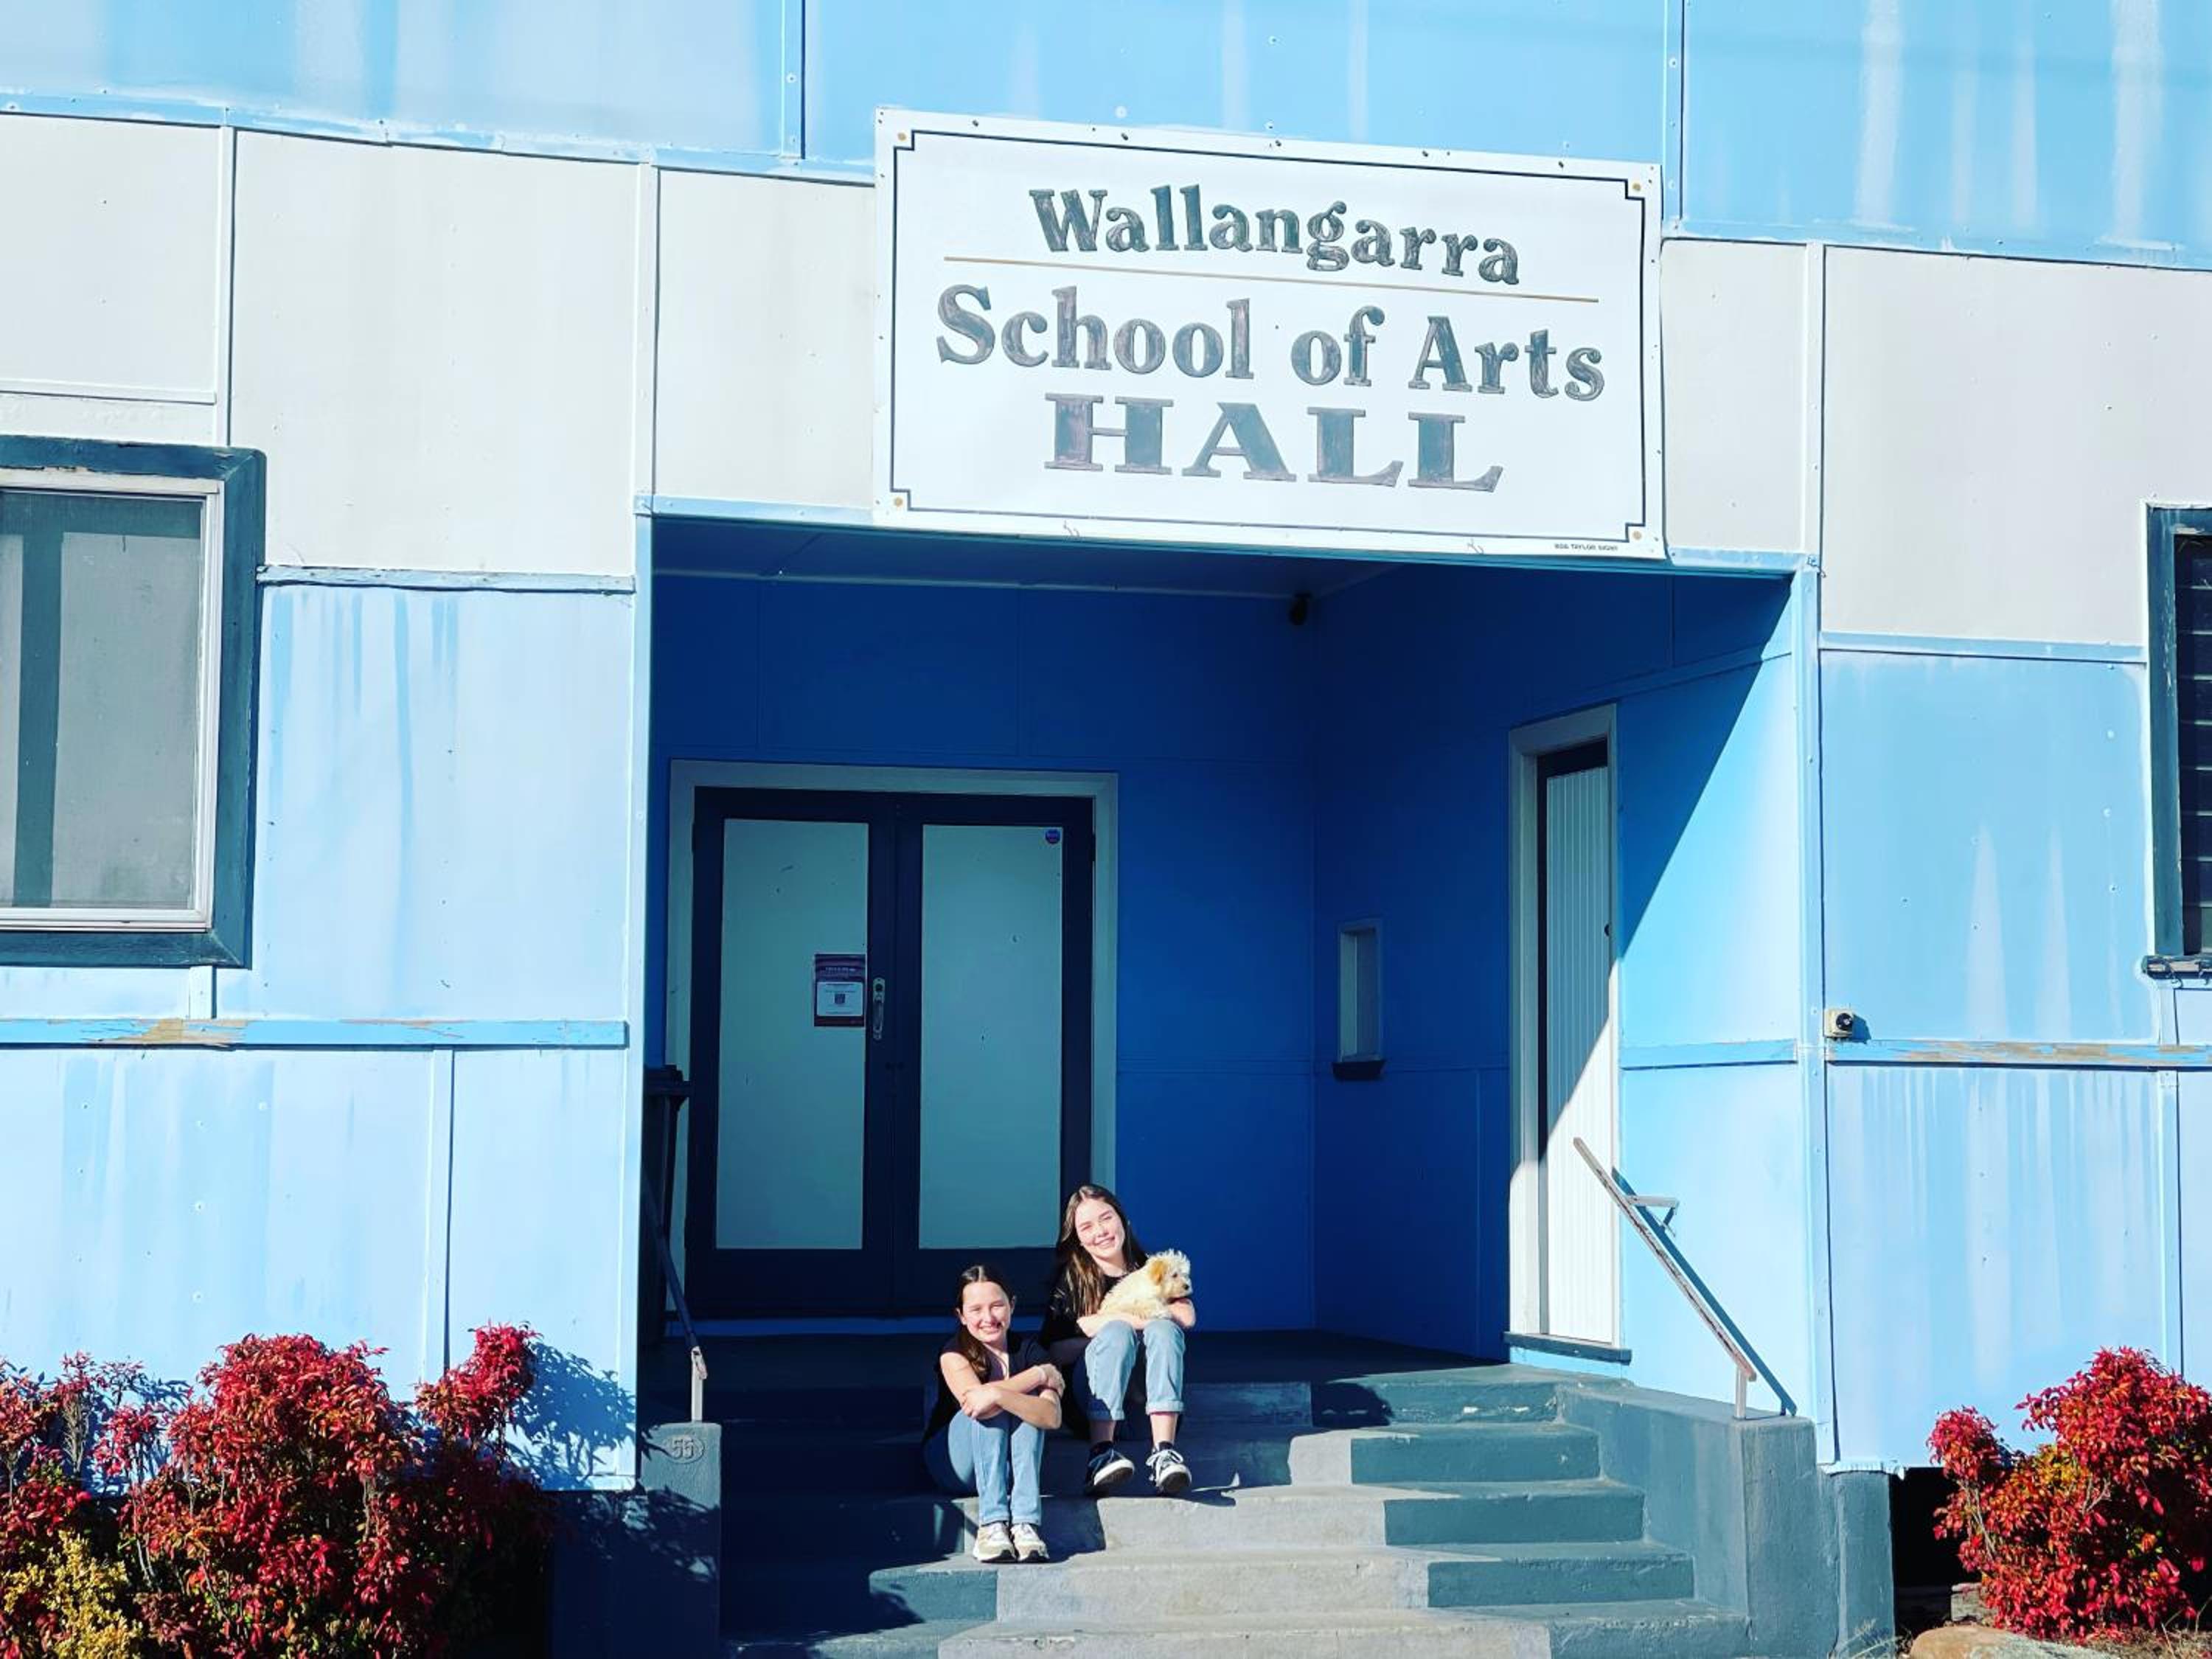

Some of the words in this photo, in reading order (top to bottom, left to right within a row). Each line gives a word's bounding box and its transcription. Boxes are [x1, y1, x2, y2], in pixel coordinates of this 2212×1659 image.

[1029, 184, 1520, 285] Wallangarra
[936, 285, 1254, 379] School
[1291, 305, 1385, 387] of
[1408, 316, 1606, 401] Arts
[1044, 393, 1503, 493] HALL
